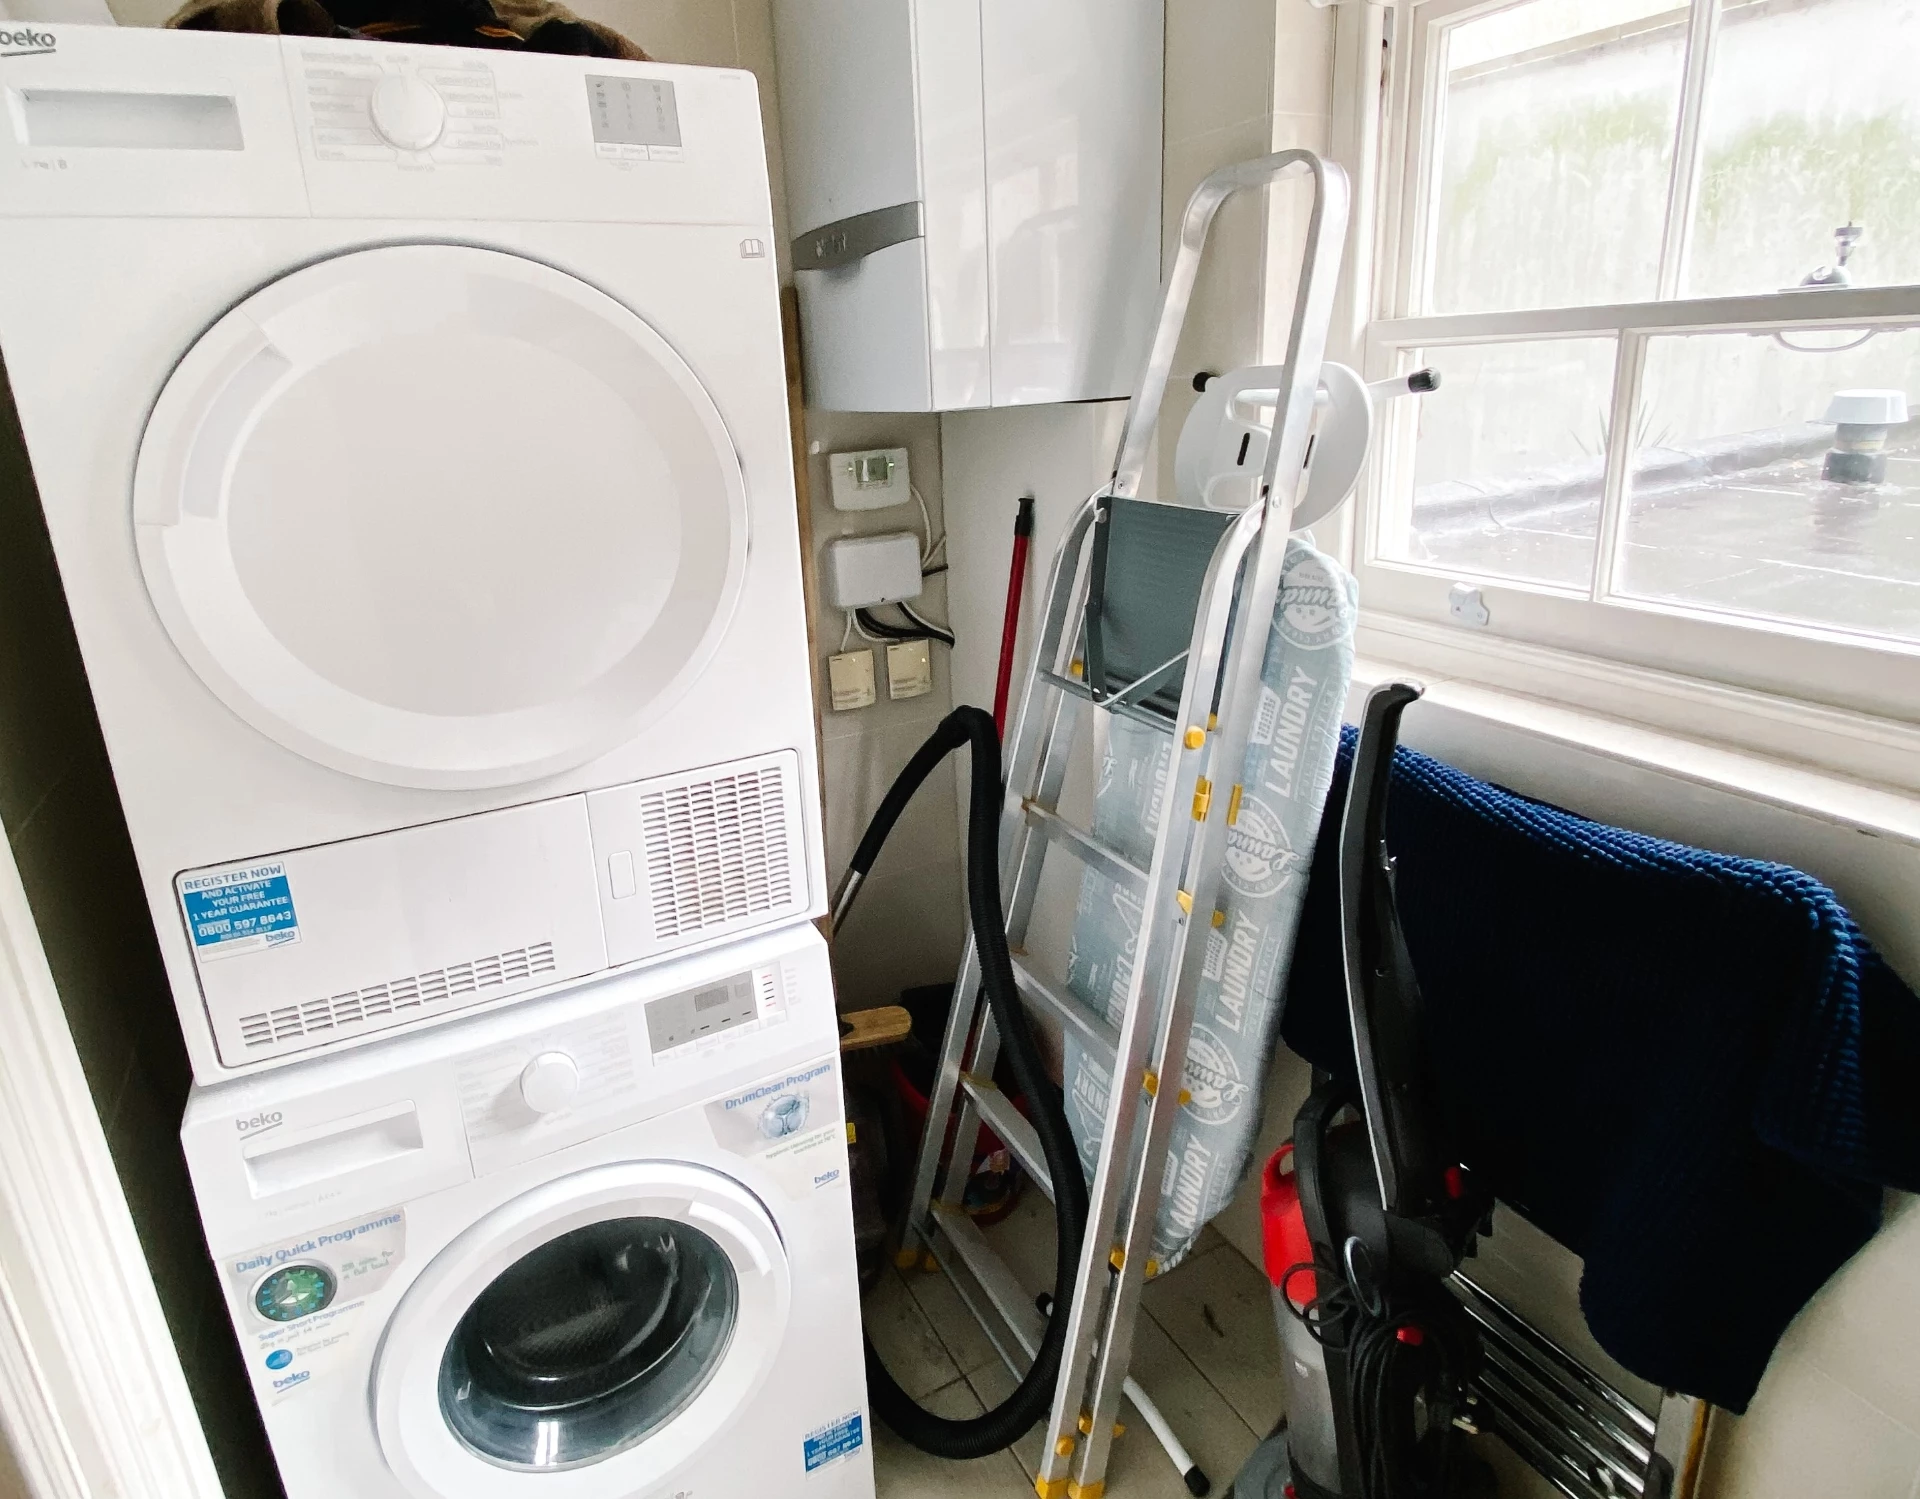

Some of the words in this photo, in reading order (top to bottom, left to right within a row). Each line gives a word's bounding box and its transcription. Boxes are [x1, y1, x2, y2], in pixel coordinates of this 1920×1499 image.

[1265, 666, 1318, 798] LAUNDRY
[184, 872, 248, 890] REGISTER
[251, 865, 282, 879] NOW
[202, 887, 223, 899] AND
[225, 880, 272, 895] ACTIVATE
[212, 895, 239, 907] YOUR
[241, 890, 265, 902] FREE
[201, 908, 228, 919] YEAR
[229, 896, 288, 914] GUARANTEE
[198, 923, 231, 937] 0800
[266, 930, 295, 942] beko
[1215, 909, 1261, 1031] LAUNDRY
[786, 1063, 831, 1090] Program
[235, 1110, 283, 1132] beko
[814, 1169, 840, 1184] beko
[1166, 1134, 1213, 1239] LAUNDRY
[236, 1252, 273, 1274] Daily
[275, 1239, 317, 1262] Quick
[318, 1212, 402, 1248] Programme
[258, 1328, 285, 1342] Super
[287, 1318, 313, 1331] Short
[313, 1300, 365, 1322] Programme
[273, 1370, 310, 1388] beko
